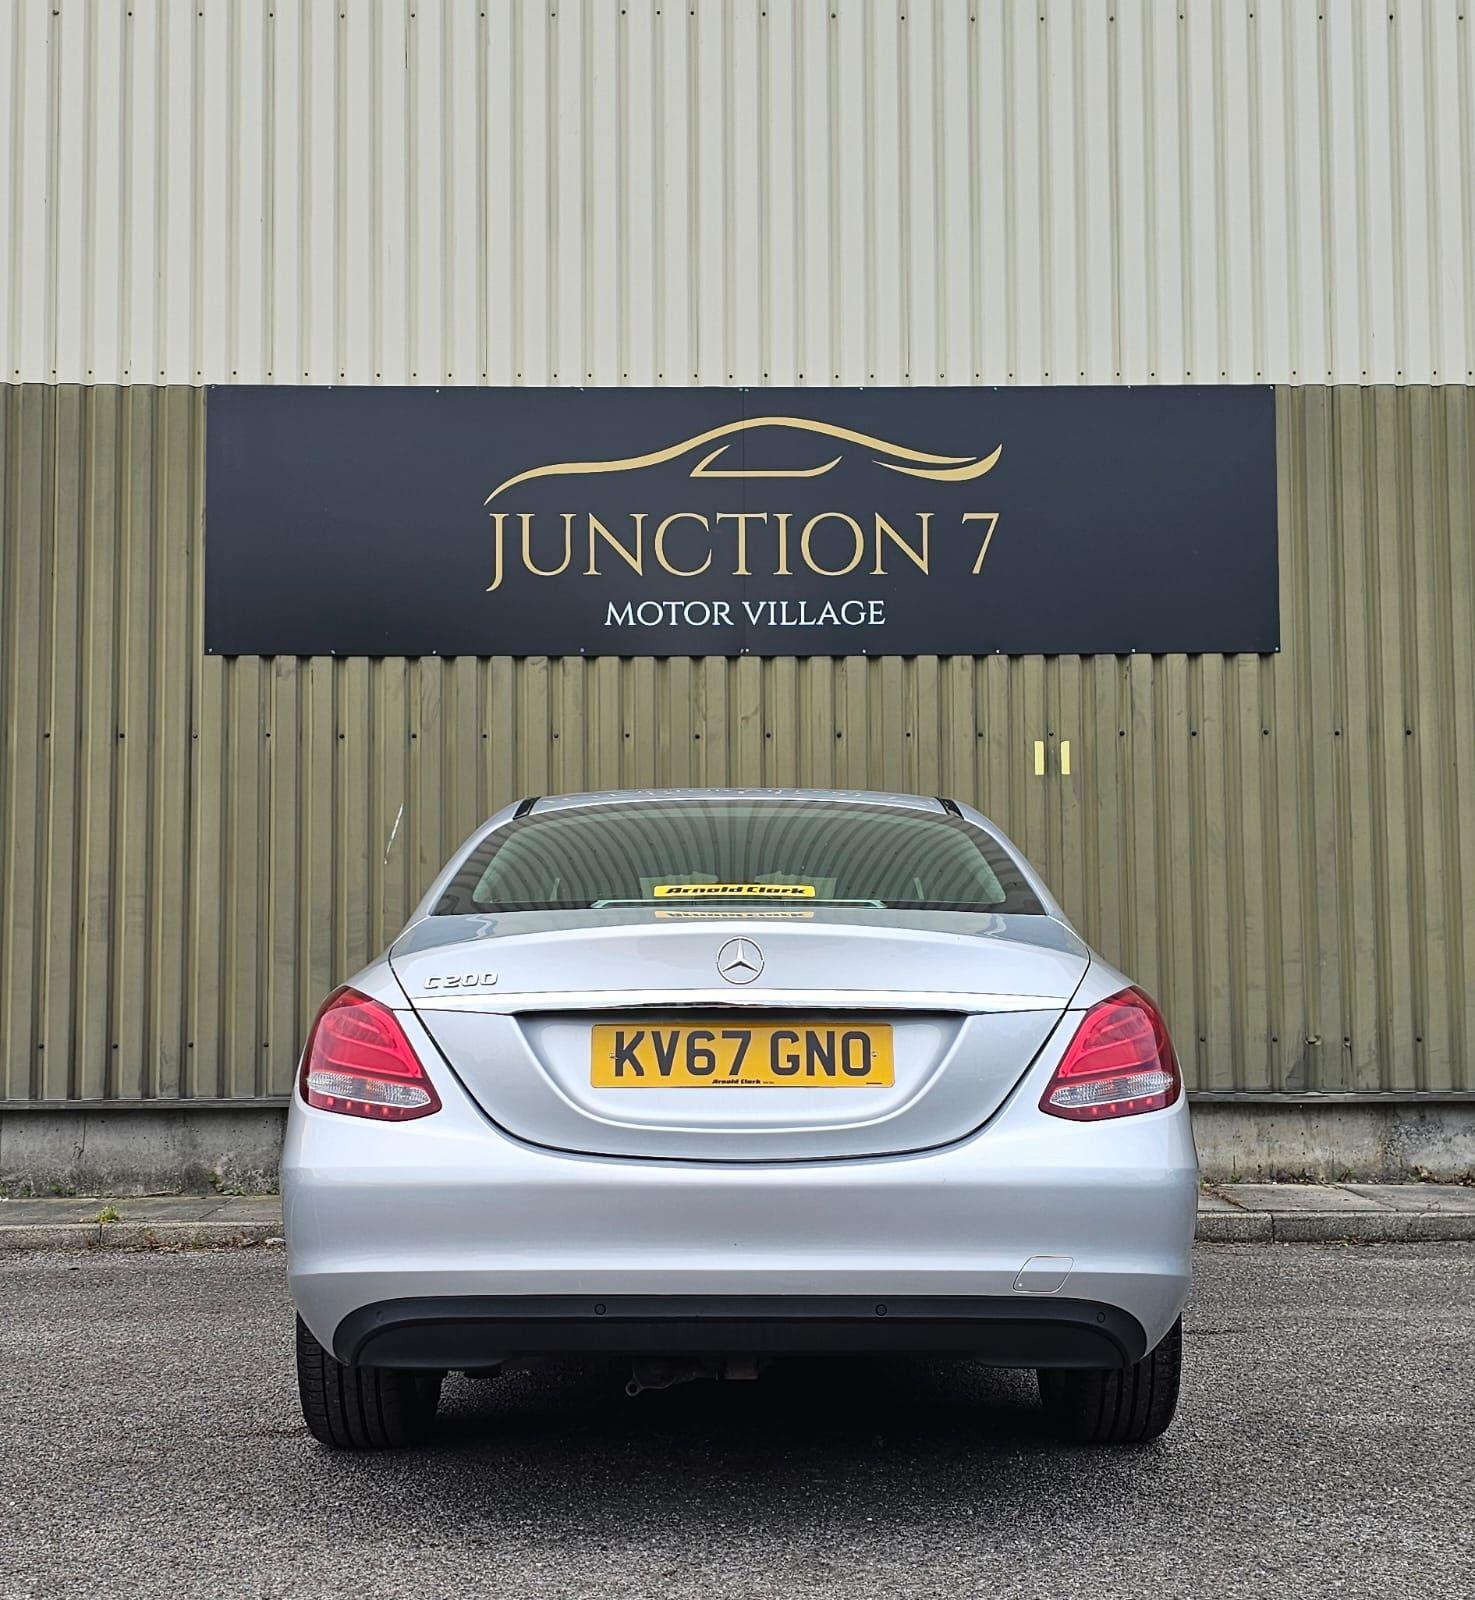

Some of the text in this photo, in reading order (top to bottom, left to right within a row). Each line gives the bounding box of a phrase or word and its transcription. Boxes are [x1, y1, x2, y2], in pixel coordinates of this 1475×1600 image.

[485, 511, 1000, 591] JUNCTION 7
[604, 600, 887, 626] MOTOR VILLAGE
[424, 971, 498, 989] C 200
[614, 1030, 872, 1077] KV67 GNO
